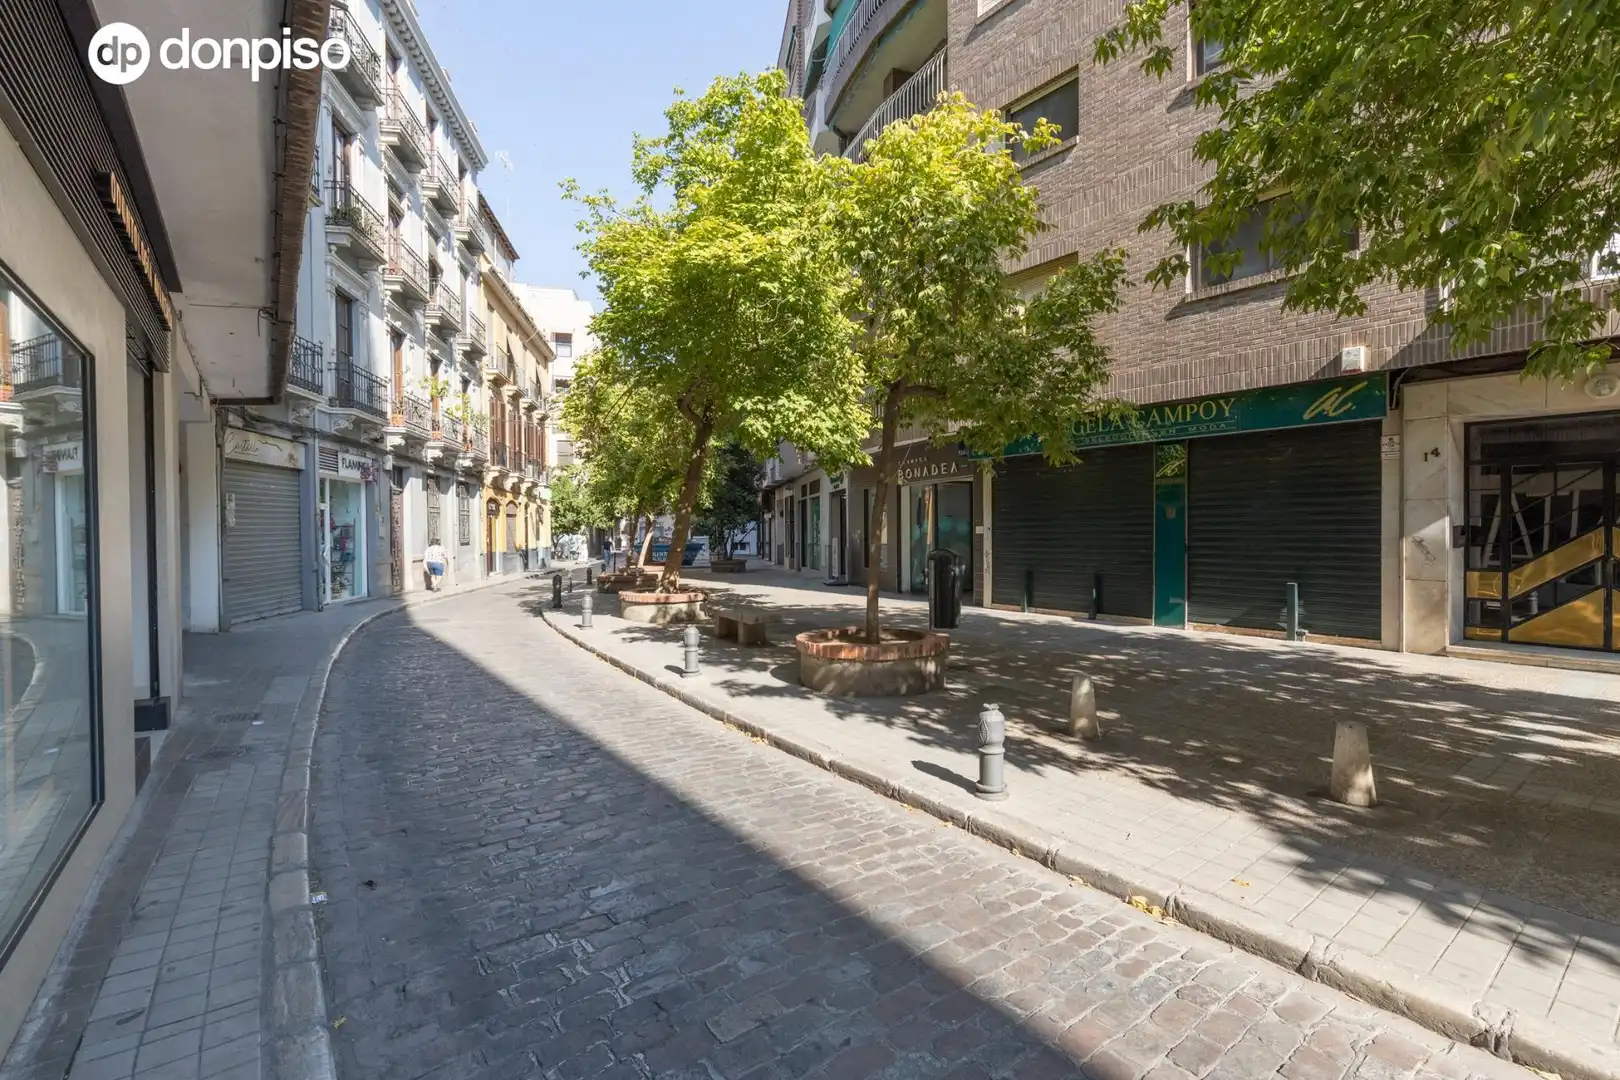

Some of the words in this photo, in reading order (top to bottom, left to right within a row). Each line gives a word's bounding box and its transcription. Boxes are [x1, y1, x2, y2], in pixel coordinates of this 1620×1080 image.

[1071, 410, 1124, 436] GELA
[1423, 447, 1441, 462] 14
[897, 461, 958, 480] BONADEA
